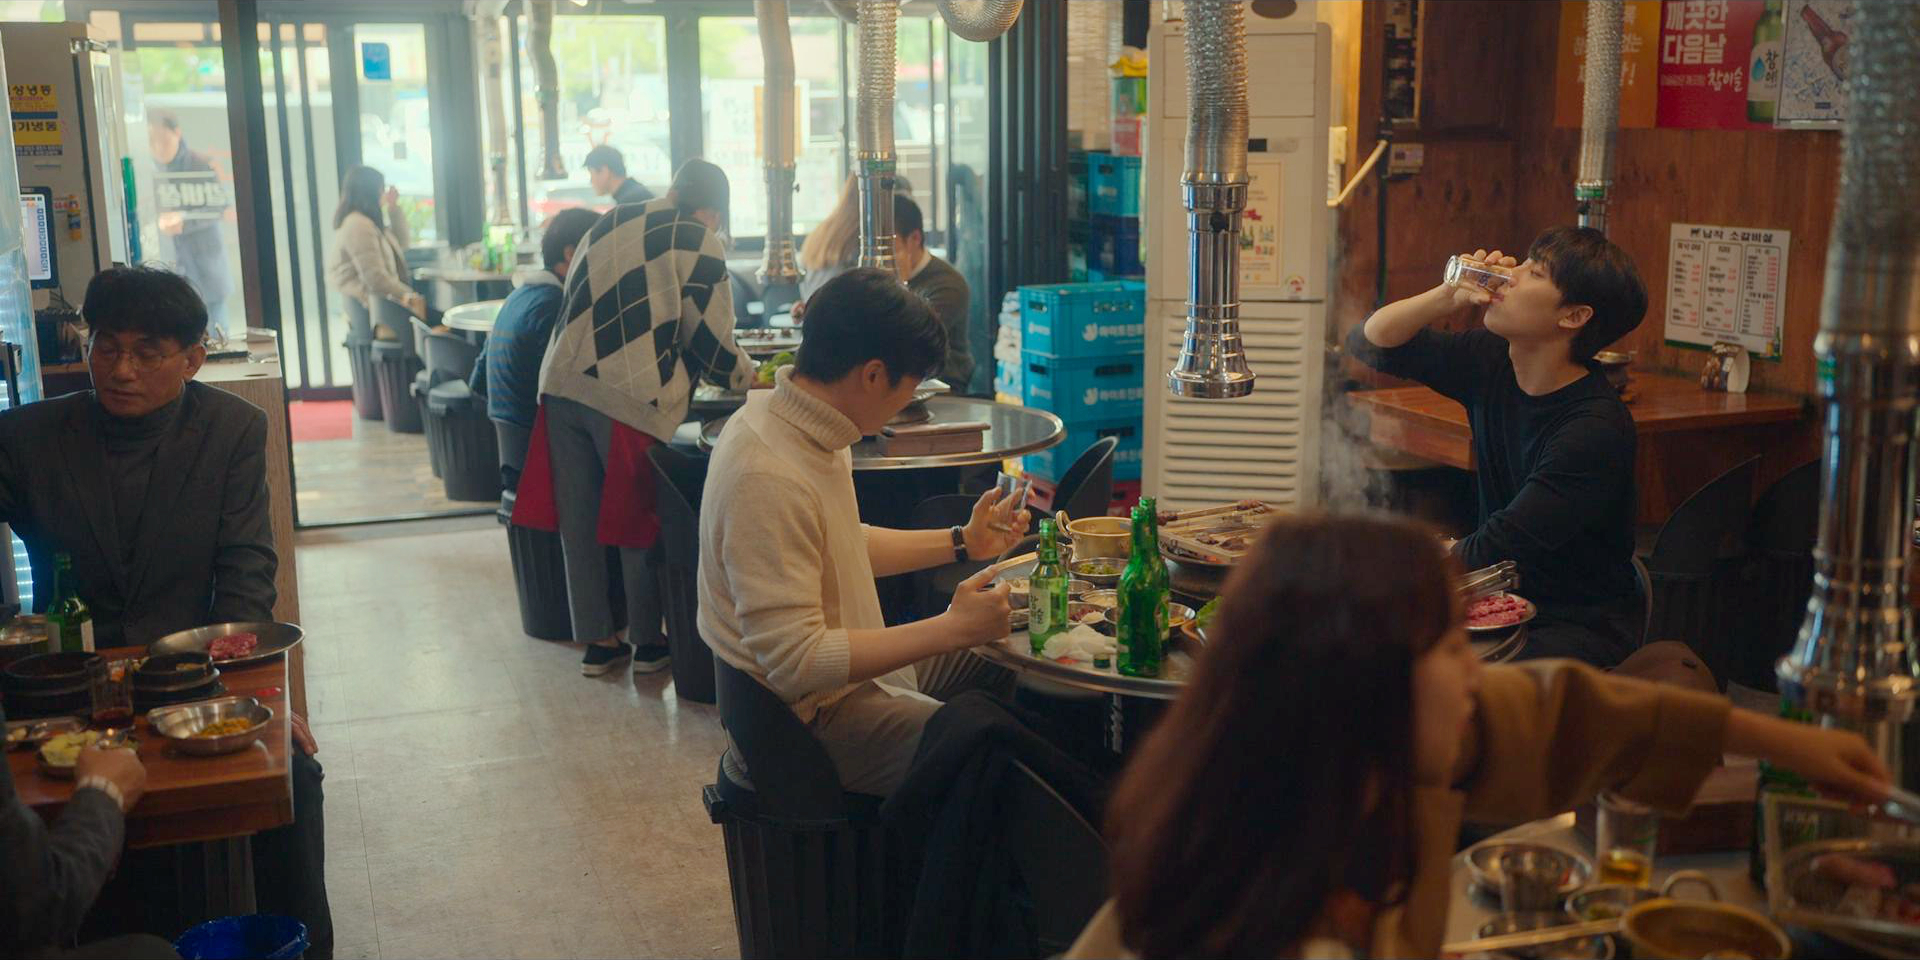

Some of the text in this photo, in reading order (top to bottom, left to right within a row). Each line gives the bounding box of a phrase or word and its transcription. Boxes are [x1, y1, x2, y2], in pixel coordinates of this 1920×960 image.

[1665, 0, 1727, 30] 깨끗한
[1664, 34, 1726, 64] 다음날
[1708, 67, 1743, 92] 참이슬
